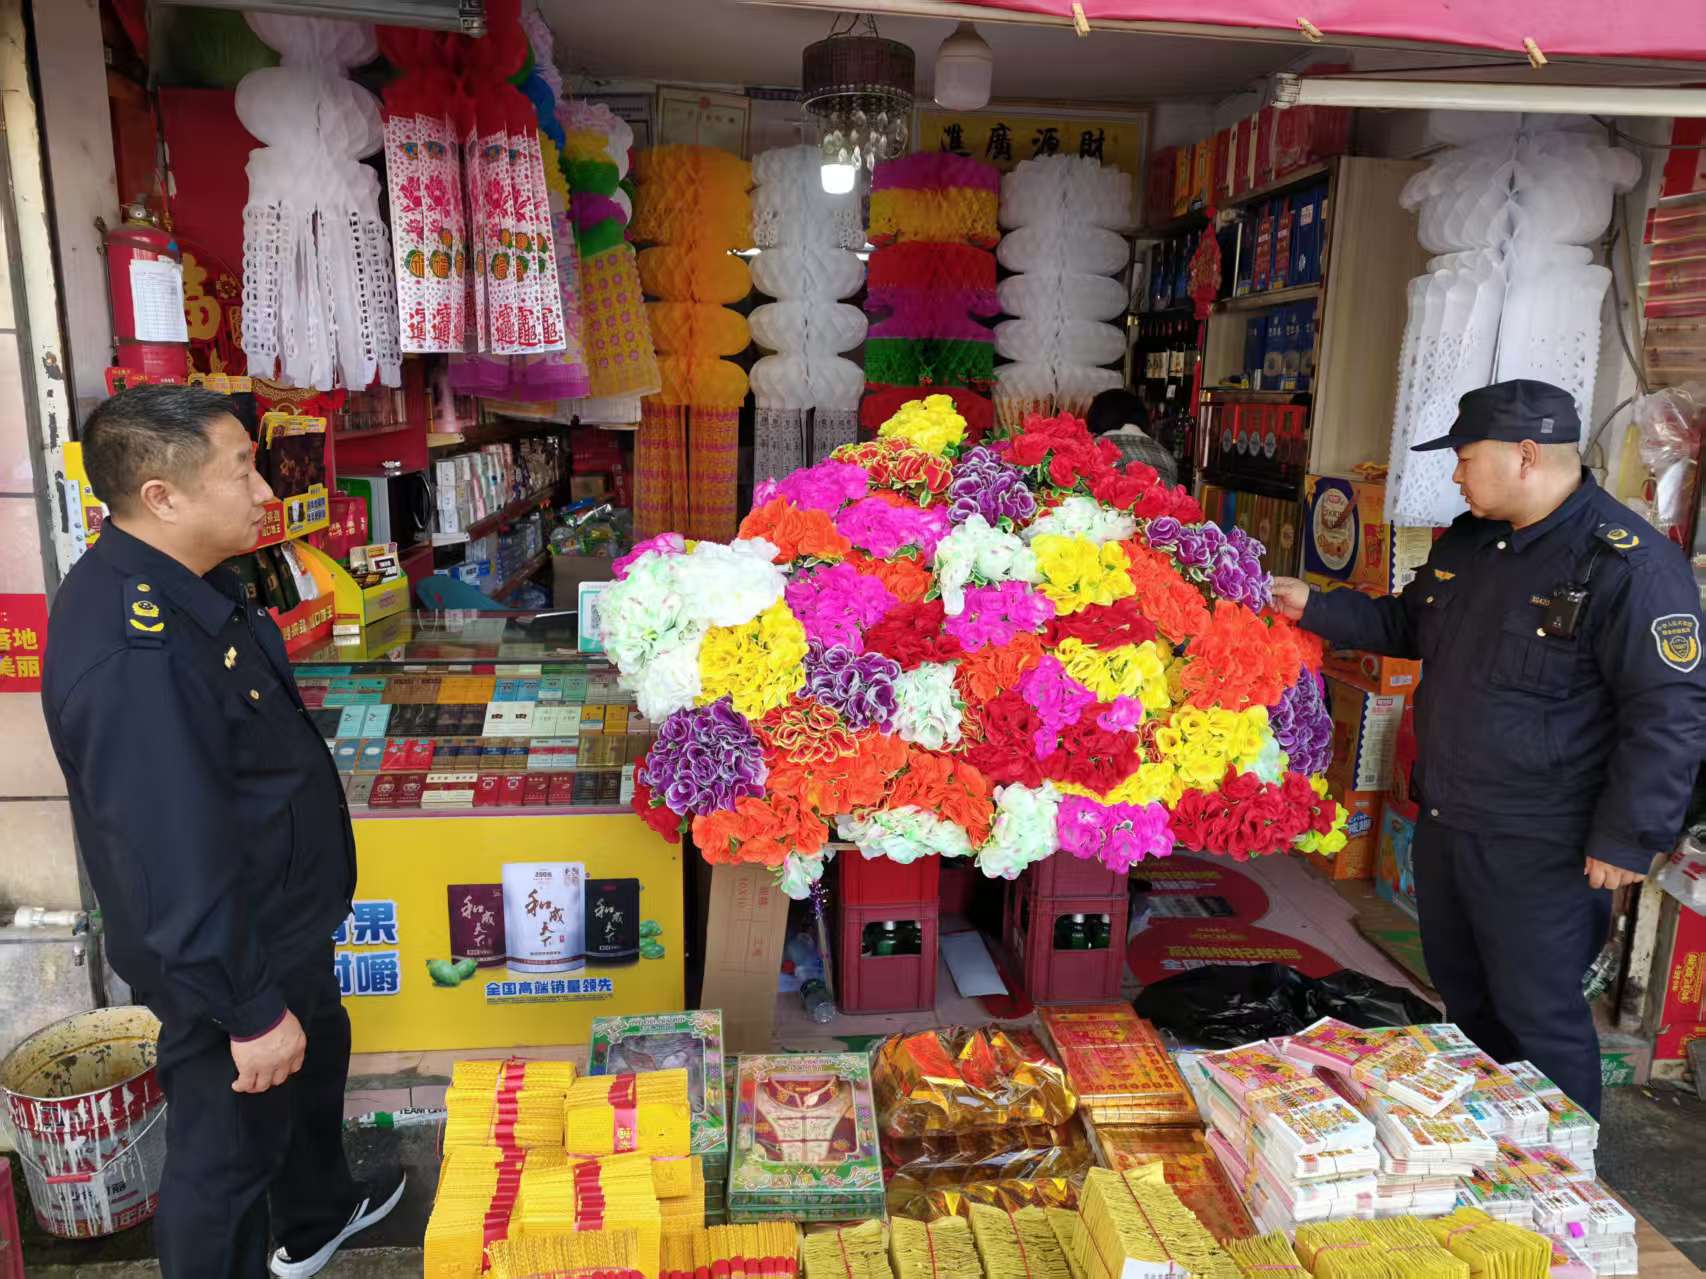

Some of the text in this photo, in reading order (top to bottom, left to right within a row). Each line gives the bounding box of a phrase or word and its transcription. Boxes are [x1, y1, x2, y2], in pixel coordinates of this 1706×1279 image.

[486, 979, 613, 997] 全国高端销量领先
